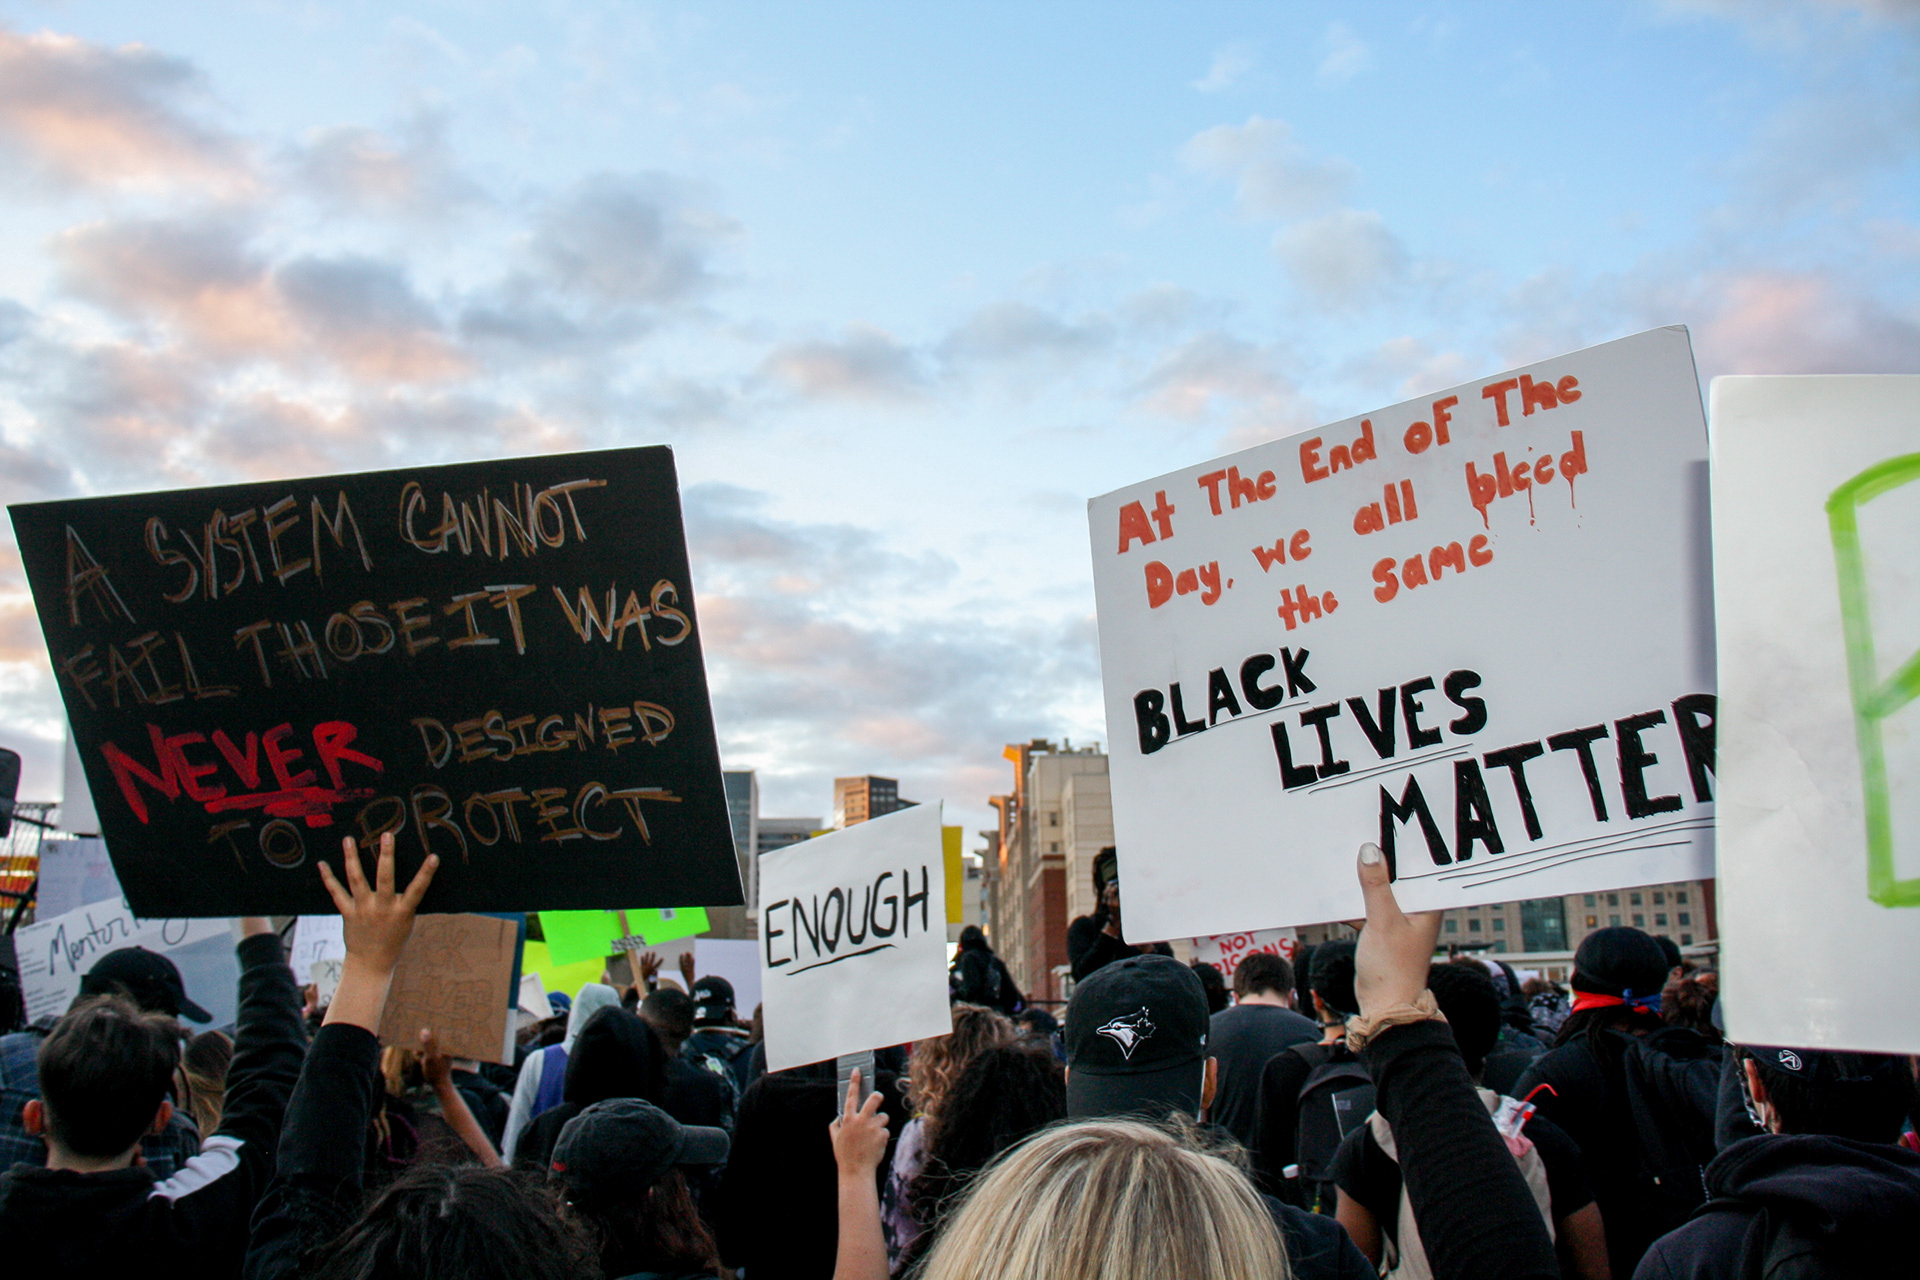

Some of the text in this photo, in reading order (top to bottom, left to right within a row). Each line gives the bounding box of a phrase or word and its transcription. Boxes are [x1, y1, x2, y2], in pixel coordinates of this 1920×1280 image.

[1117, 490, 1176, 555] At
[1198, 465, 1277, 516] The
[1299, 418, 1376, 484] End
[1482, 374, 1583, 427] The
[1252, 528, 1312, 573] we
[1353, 479, 1418, 535] all
[1464, 430, 1588, 516] bleed
[64, 479, 608, 626] A SYSTEM CANNOT
[1277, 533, 1495, 631] the same
[59, 630, 240, 709] FAIL
[553, 578, 693, 652] WAS
[1133, 646, 1318, 755] BLACK
[101, 700, 677, 826] NEVER DESIGNED
[1269, 669, 1487, 791] LIVES
[1378, 693, 1717, 884] MATTER
[209, 781, 684, 873] TO PROTECT
[765, 865, 929, 968] ENOUGH
[1219, 931, 1257, 955] NOT
